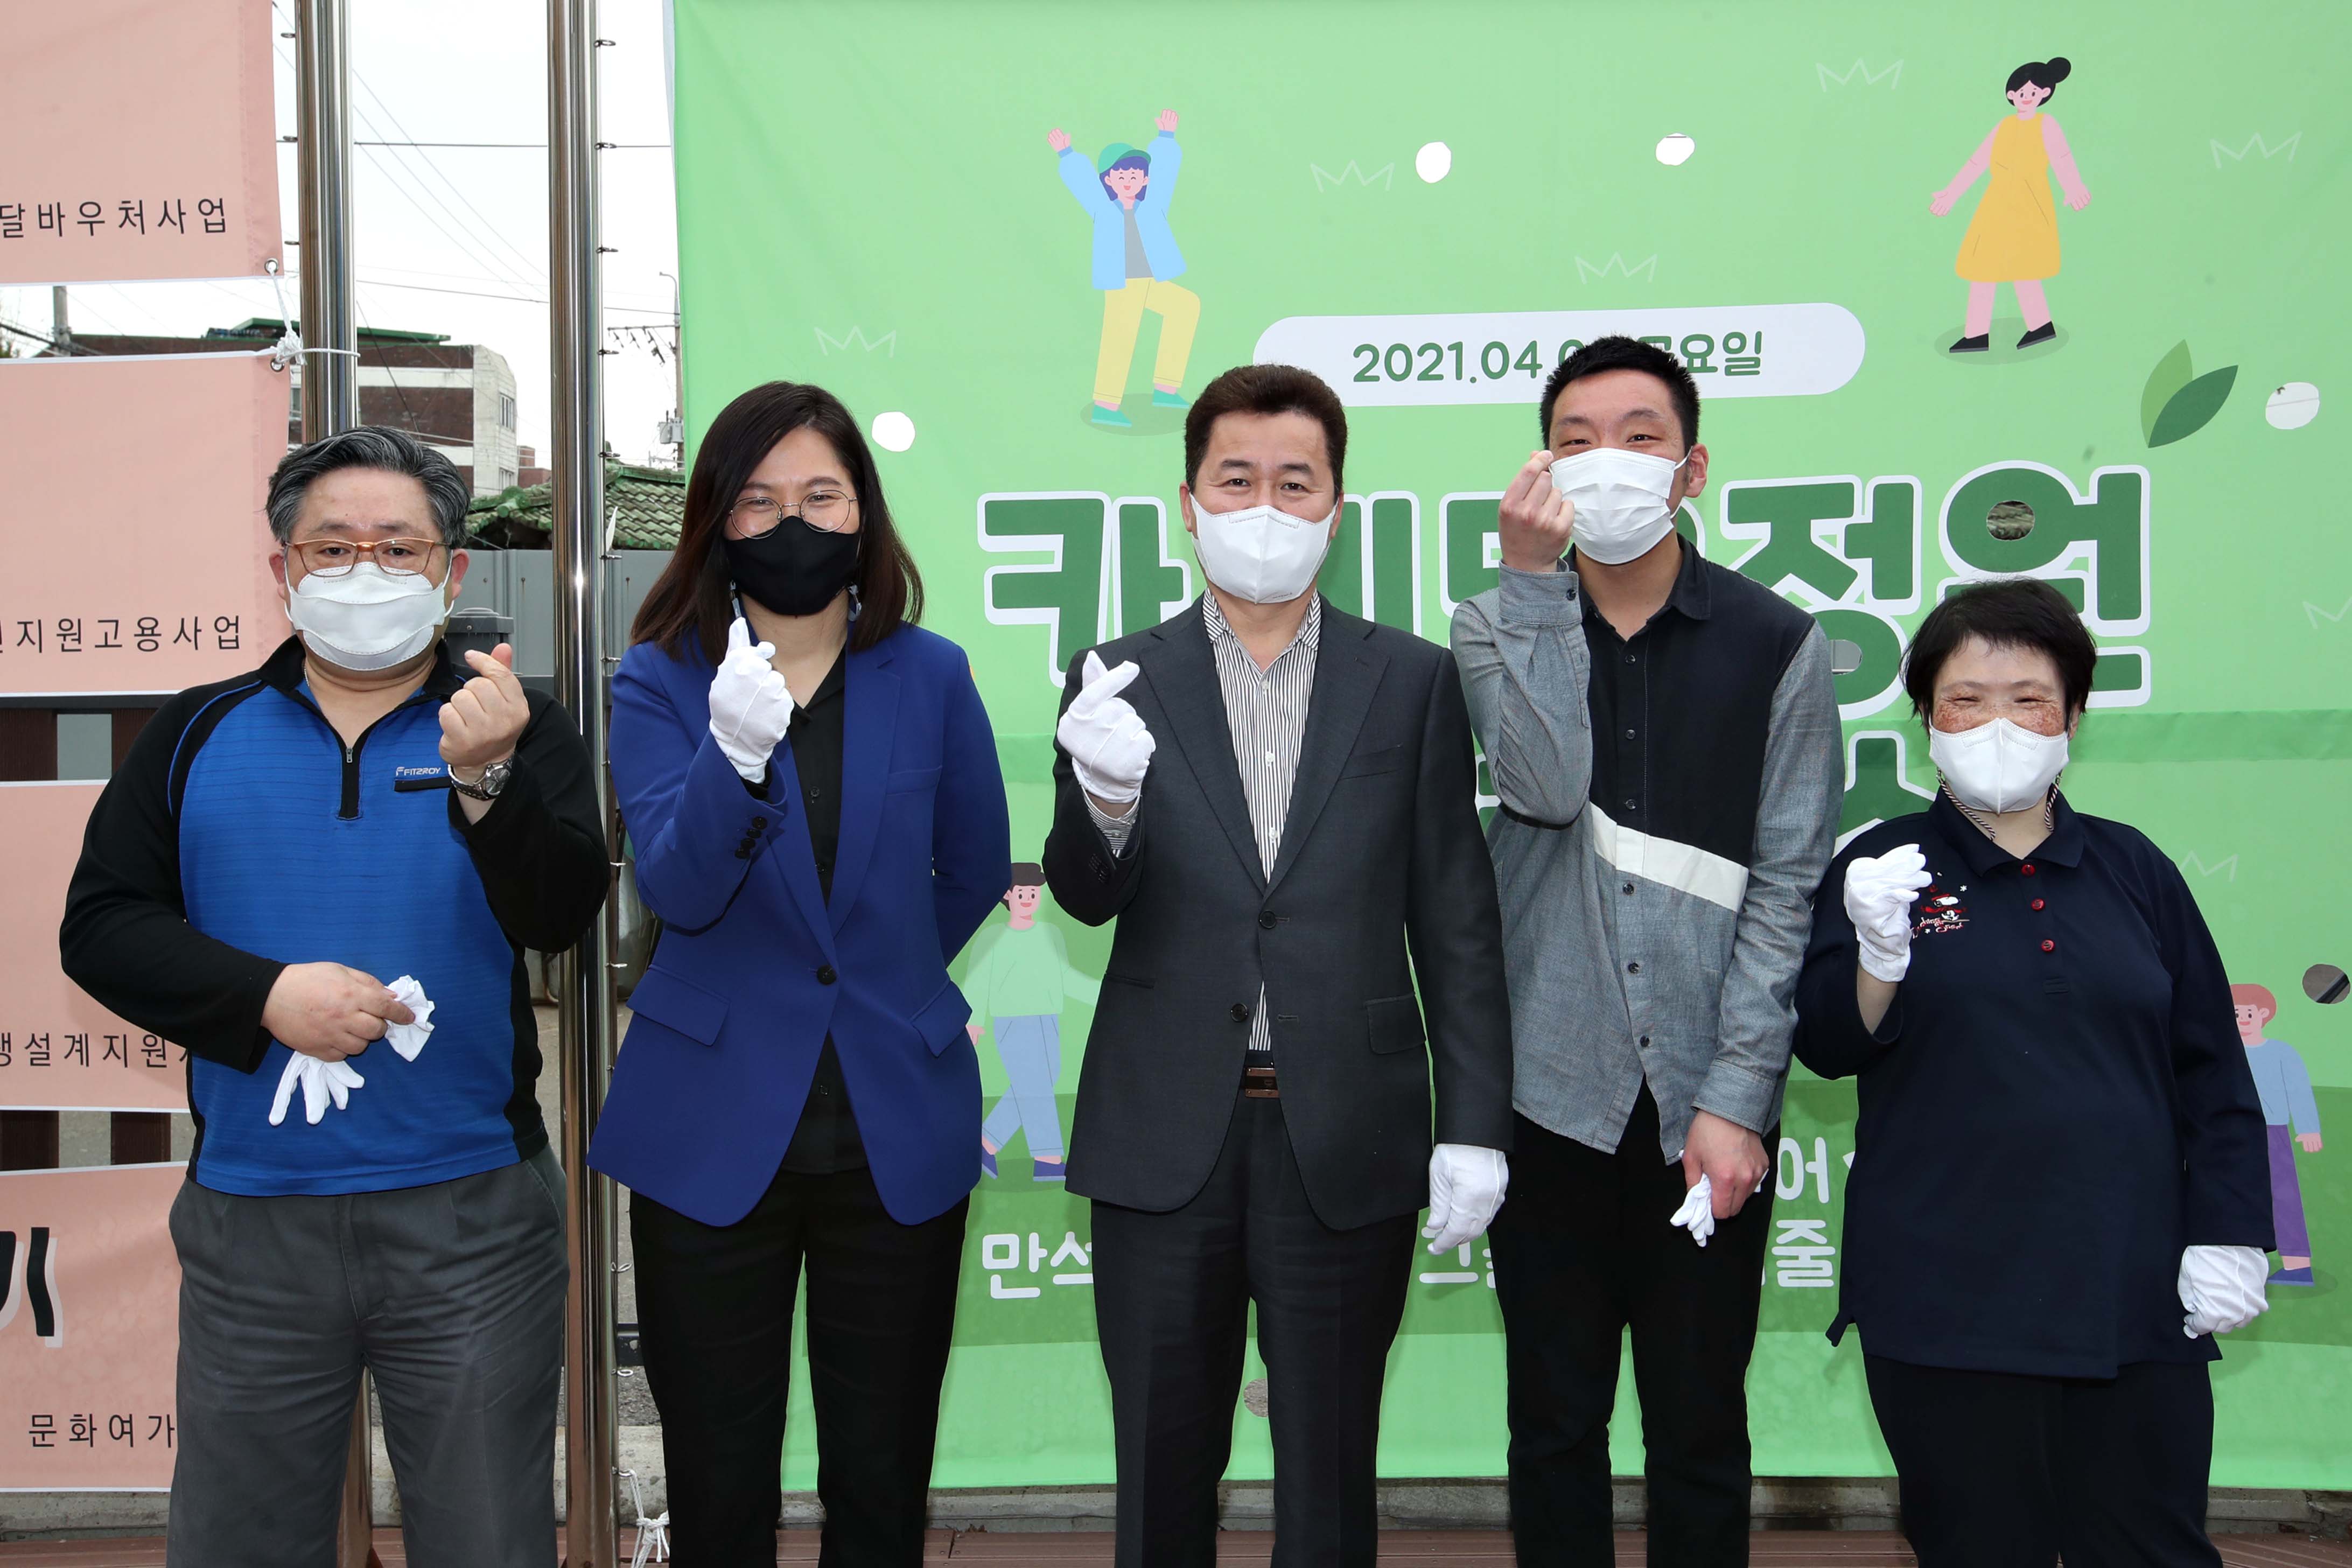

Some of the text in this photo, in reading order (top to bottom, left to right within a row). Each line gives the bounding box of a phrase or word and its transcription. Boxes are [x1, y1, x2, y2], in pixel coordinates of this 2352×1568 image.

[0, 198, 226, 238] 달바우처사업
[1637, 331, 1763, 376] 요일
[0, 615, 240, 654] 지원고용사업
[0, 1032, 187, 1068] 설계지원
[1761, 1219, 1836, 1287] 줄
[29, 1413, 176, 1448] 문화여가
